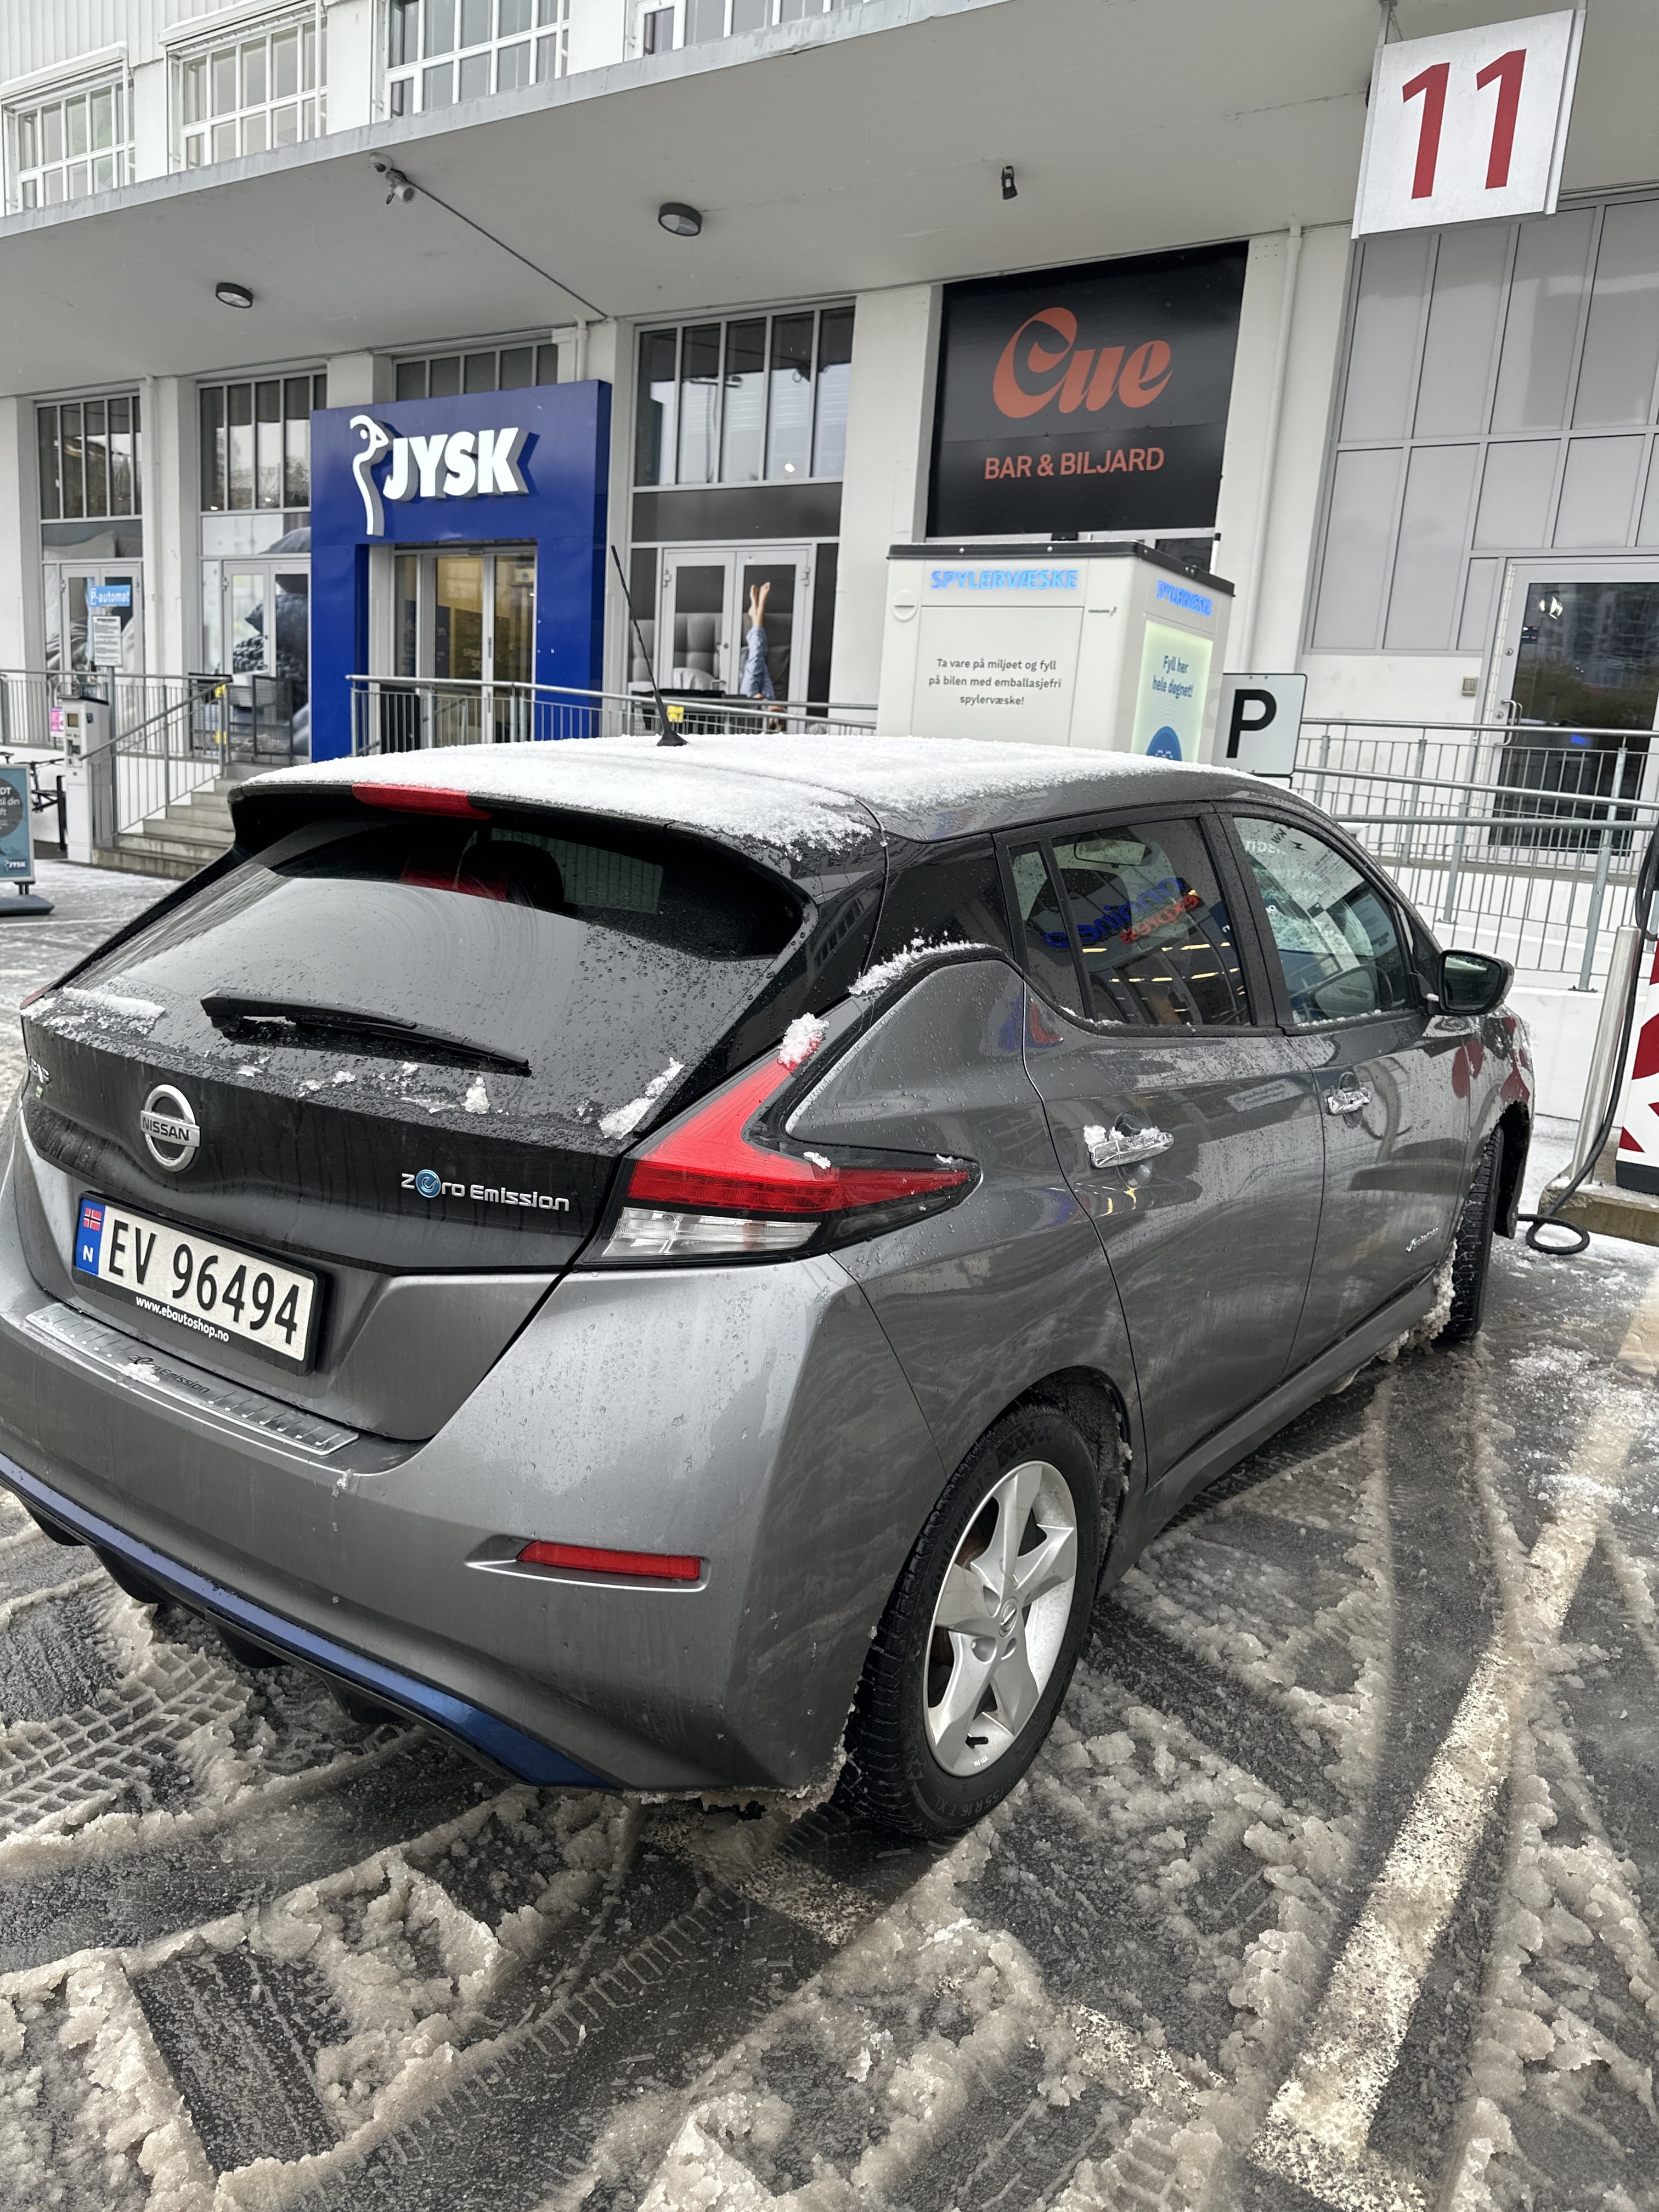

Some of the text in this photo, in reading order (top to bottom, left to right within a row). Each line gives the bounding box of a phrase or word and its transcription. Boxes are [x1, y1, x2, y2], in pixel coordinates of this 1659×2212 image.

[1402, 48, 1527, 200] 11
[992, 307, 1173, 419] Cue
[383, 427, 524, 501] JYSK
[984, 447, 1165, 480] BAR & BILJARD
[930, 569, 1080, 590] SPYLERVÆSKE
[937, 658, 1057, 672] Ta vare på miljøet og fyll
[1163, 655, 1189, 674] Fyll her
[928, 674, 1062, 690] på bilen med emballasjefri
[1152, 675, 1167, 692] hele
[960, 695, 1025, 706] spylervæske!
[1226, 688, 1278, 759] P
[143, 1116, 189, 1142] NISSAN
[470, 1184, 570, 1212] Emission
[82, 1245, 94, 1263] N
[109, 1218, 301, 1346] EV 96494
[136, 1296, 229, 1342] www.ebautoshop.no
[159, 1368, 211, 1394] Emission
